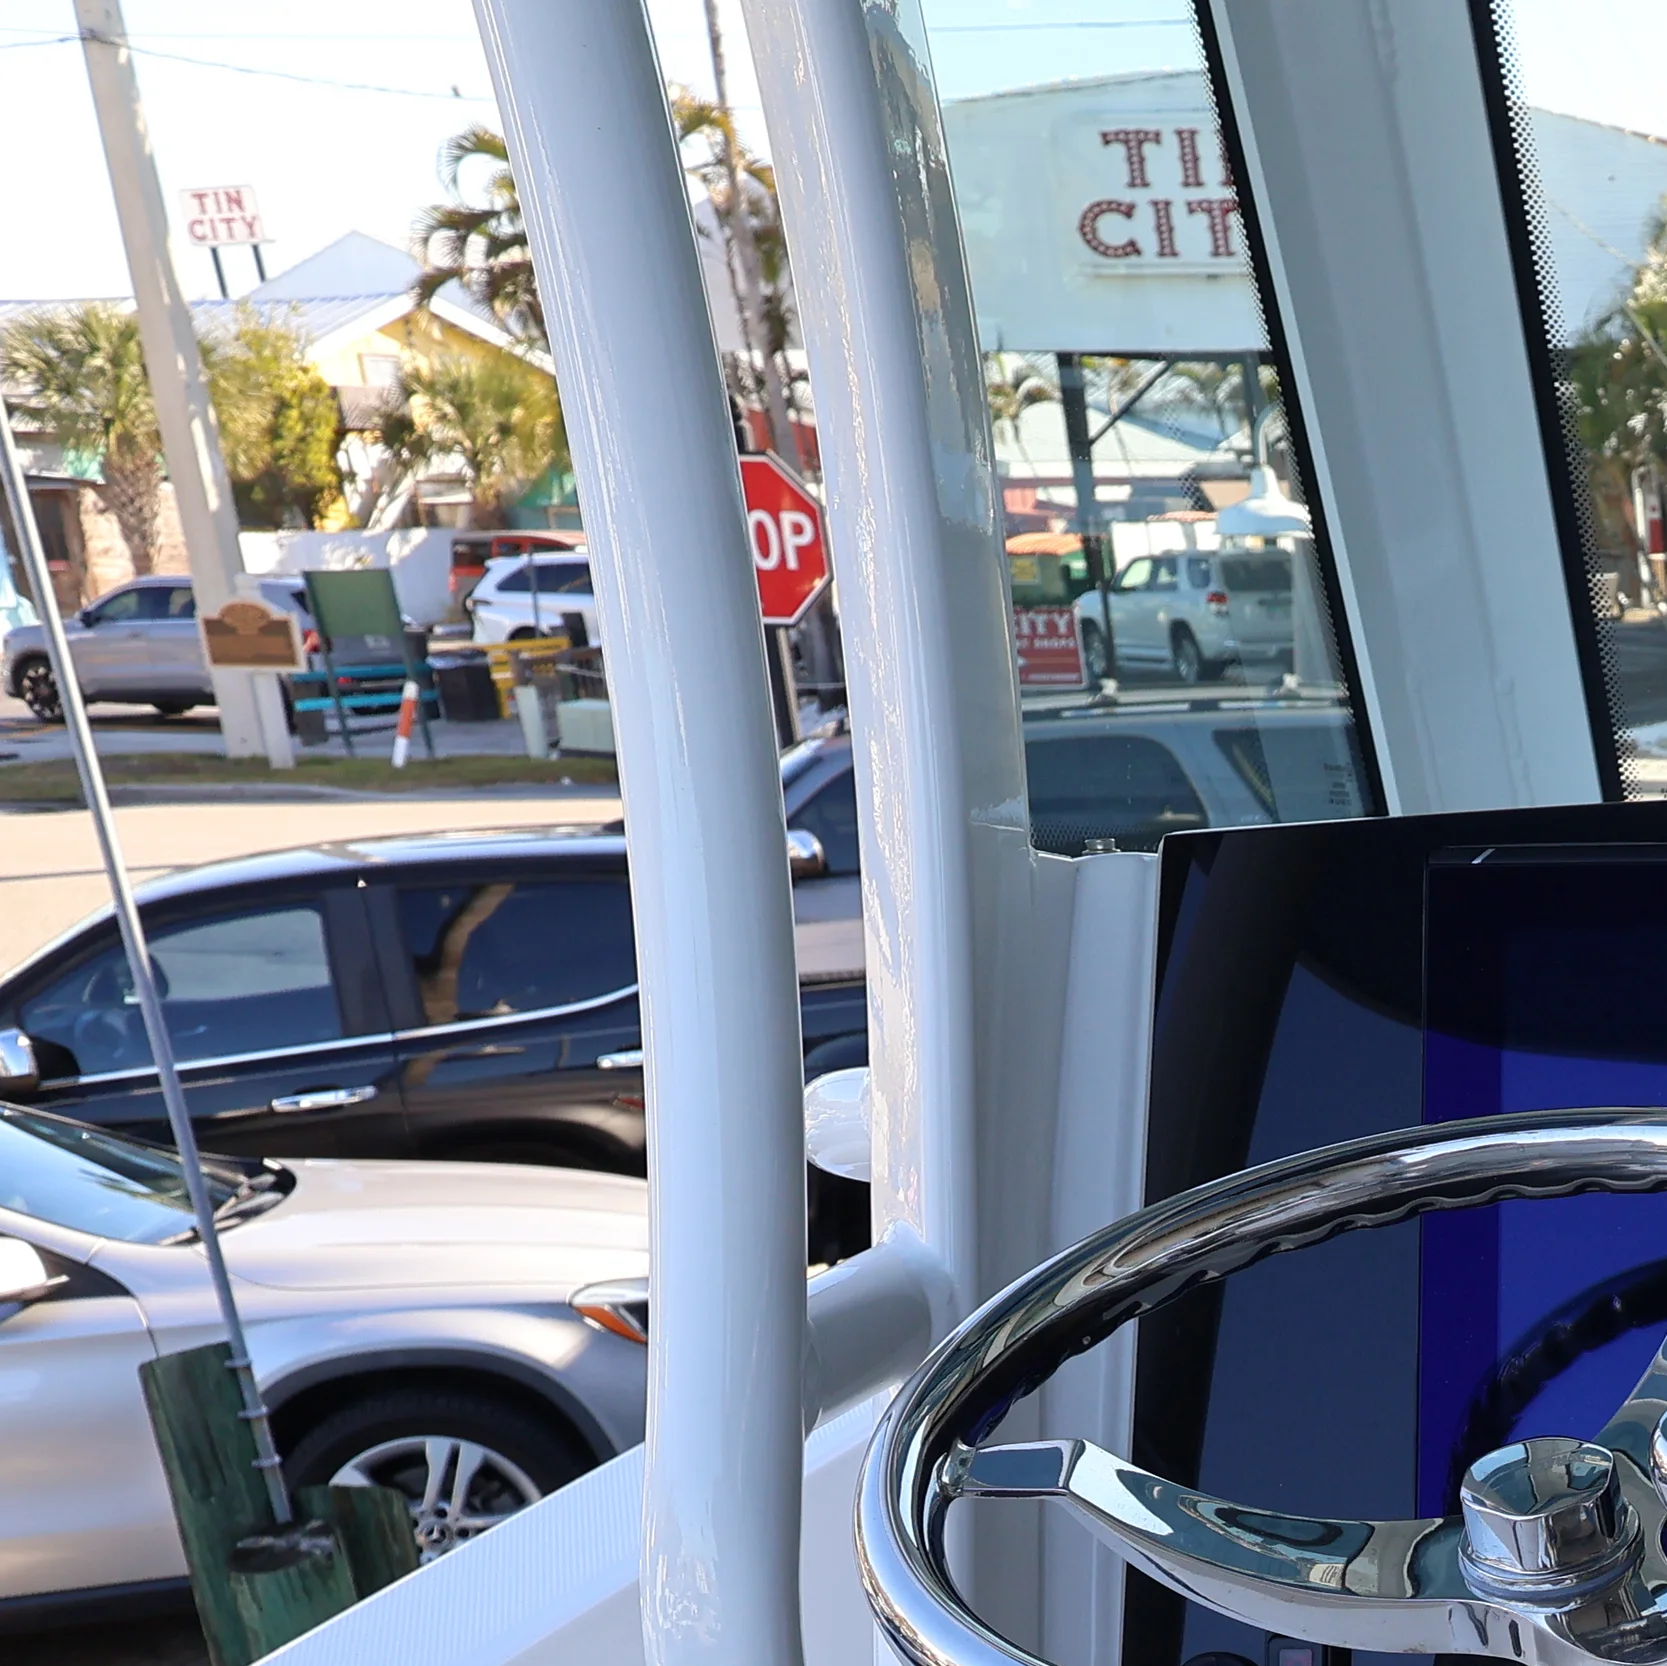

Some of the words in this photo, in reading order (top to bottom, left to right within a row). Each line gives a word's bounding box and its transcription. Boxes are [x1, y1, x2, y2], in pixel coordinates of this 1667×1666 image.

[1099, 128, 1233, 188] TI
[187, 215, 257, 241] CITY
[190, 189, 246, 215] TIN
[1077, 198, 1240, 258] CIT
[748, 509, 815, 571] OP
